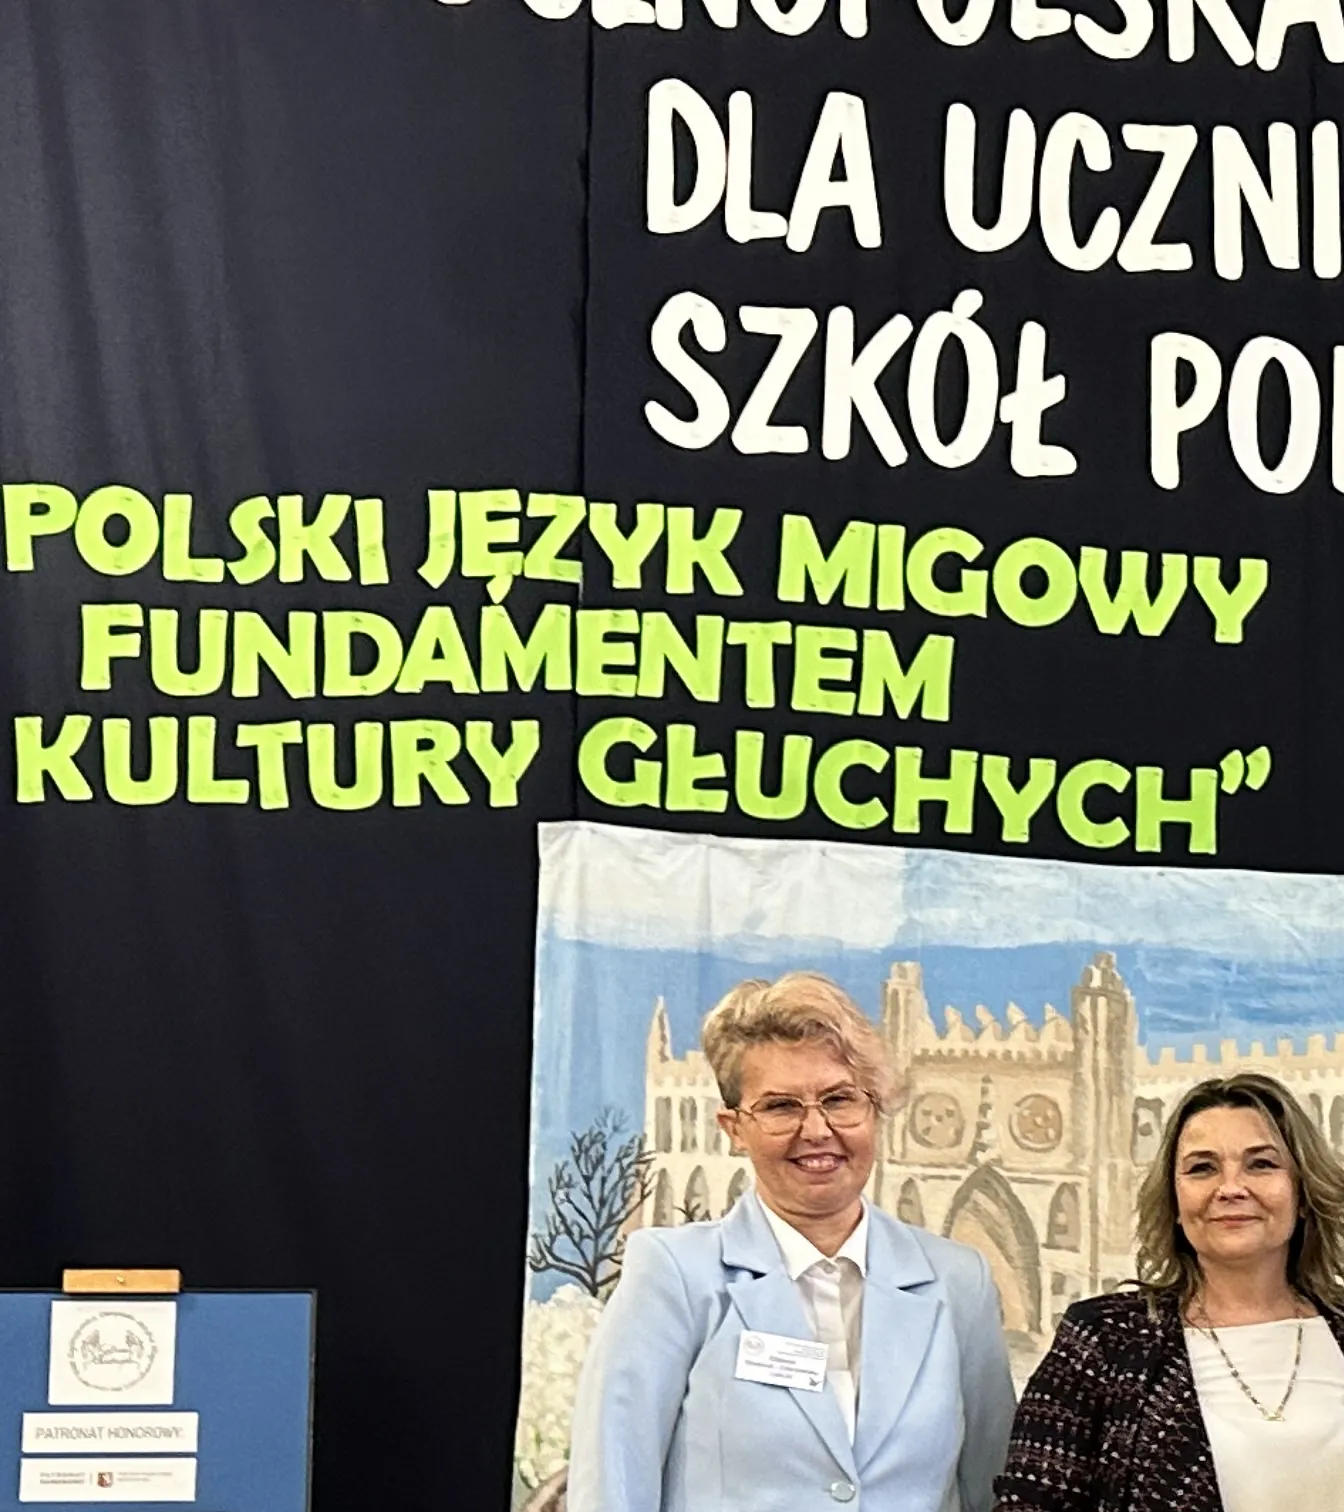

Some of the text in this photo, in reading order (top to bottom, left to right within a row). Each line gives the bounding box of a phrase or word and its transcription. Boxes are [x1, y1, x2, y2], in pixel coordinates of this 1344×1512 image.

[647, 79, 881, 252] DLA
[645, 289, 1076, 477] SZKÓŁ
[3, 484, 1266, 642] POLSKI JĘZYK MIGOWY
[80, 603, 953, 719] FUNDAMENTEM
[14, 717, 1270, 853] KULTURY GŁUCHYCH”
[35, 1426, 103, 1440] PATRONAT
